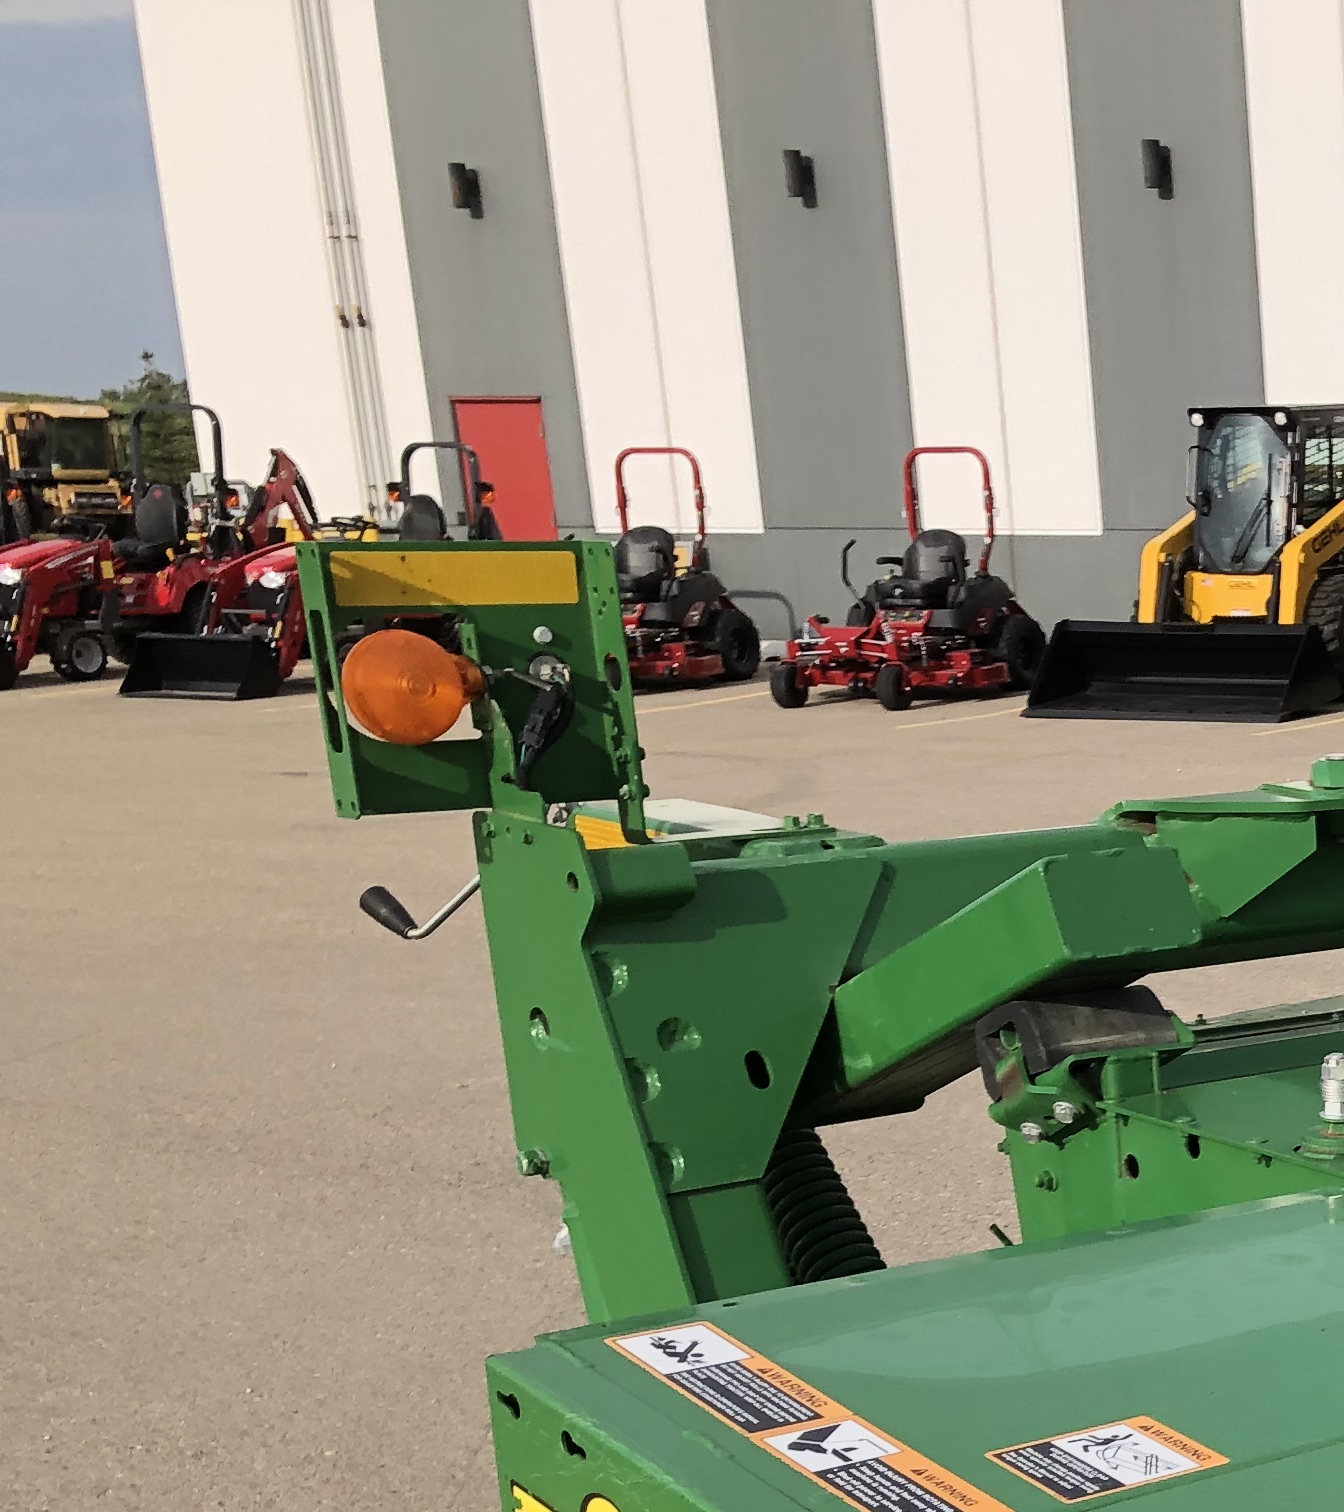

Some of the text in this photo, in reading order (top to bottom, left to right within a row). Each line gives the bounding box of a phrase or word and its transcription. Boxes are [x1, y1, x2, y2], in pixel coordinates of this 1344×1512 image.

[769, 1370, 828, 1408] WARNING
[1151, 1430, 1213, 1463] WARNING
[923, 1474, 979, 1508] WARNING
